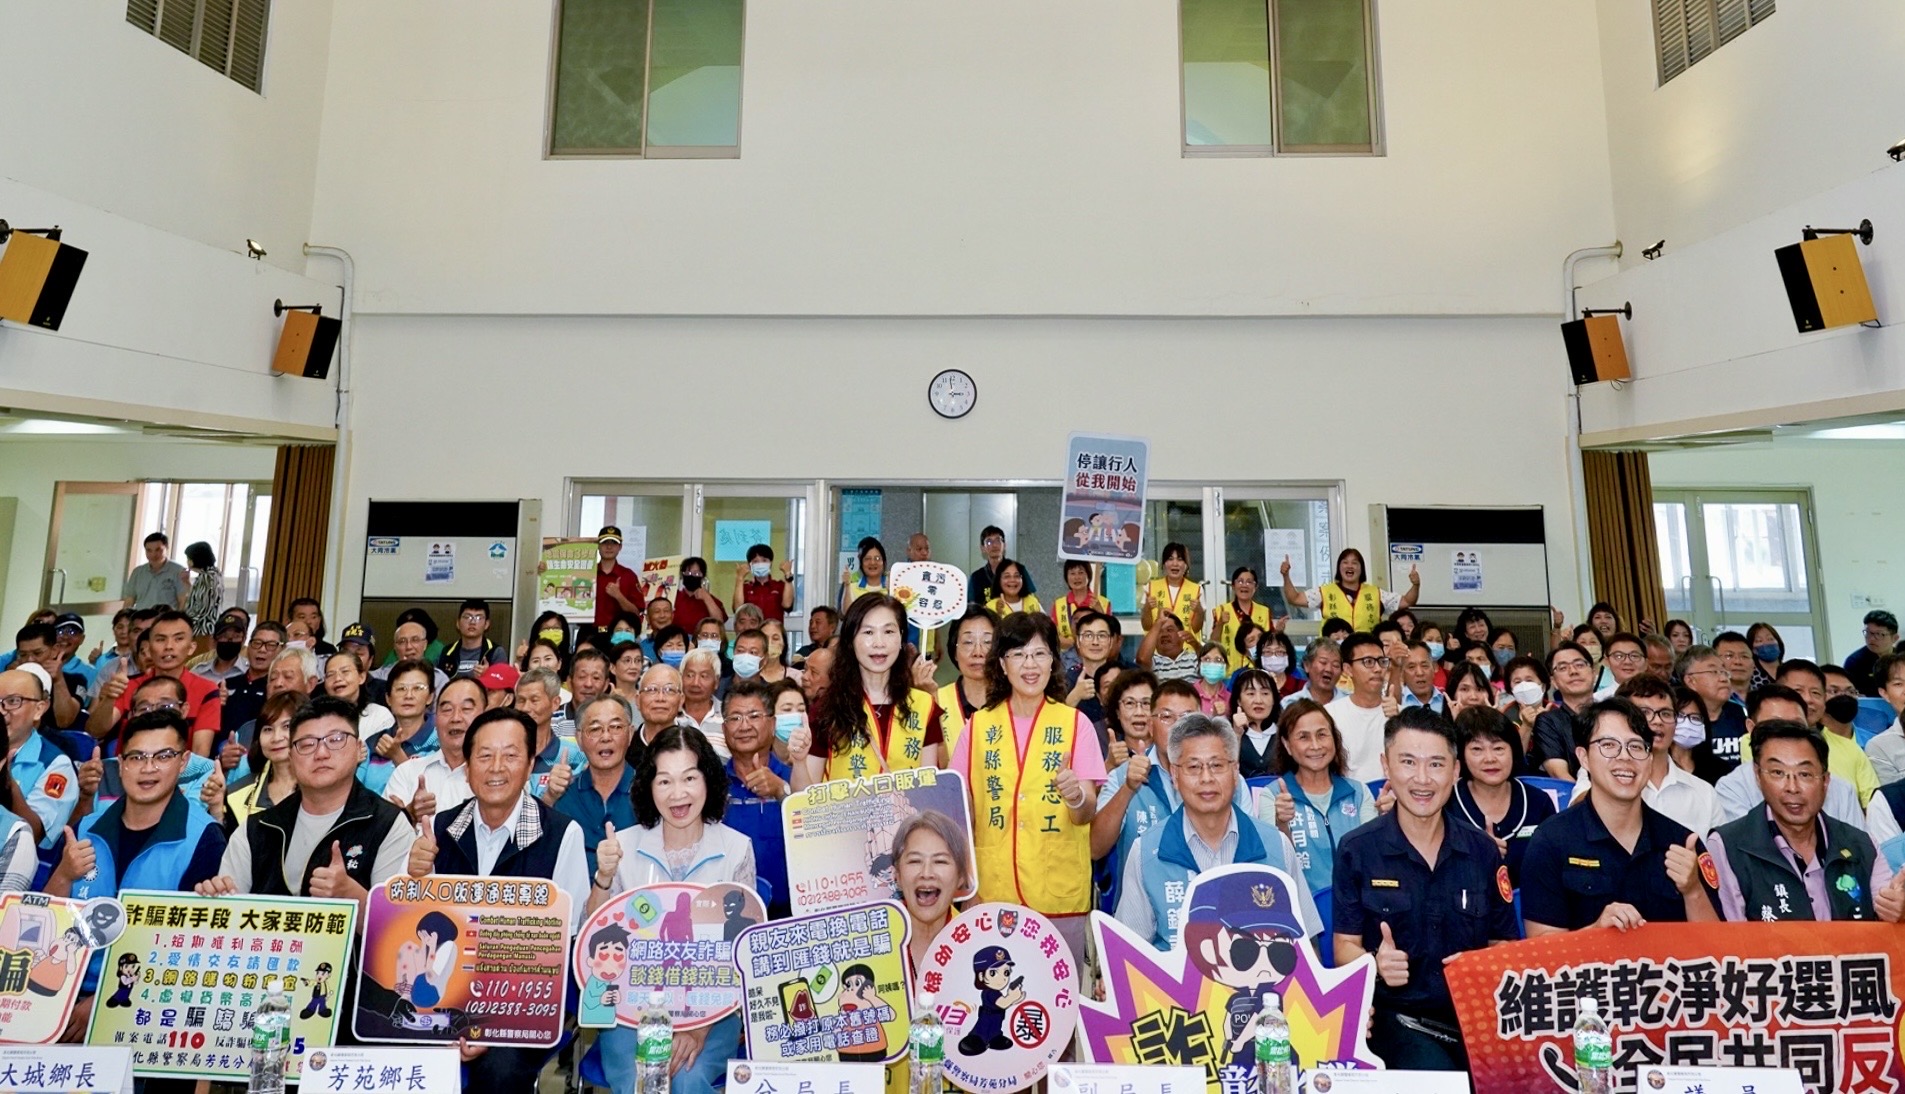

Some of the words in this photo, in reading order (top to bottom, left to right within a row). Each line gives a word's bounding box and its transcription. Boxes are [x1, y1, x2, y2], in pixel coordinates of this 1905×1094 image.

[1077, 453, 1137, 473] 停讓行人
[1075, 472, 1136, 492] 從我開始
[919, 597, 943, 610] 容忍
[927, 585, 938, 596] 零
[807, 769, 938, 805] 打擊人口販運
[984, 723, 1005, 831] 彰縣警局
[1040, 725, 1064, 834] 服務志工
[23, 894, 49, 907] ATM
[390, 880, 549, 905] 防制人口販運通報專線
[1774, 884, 1792, 914] 鎮長
[126, 904, 231, 930] 詐騙新手段
[240, 908, 347, 934] 大家要防範
[749, 907, 889, 954] 親友來電換電話
[629, 938, 732, 962] 網路交友詐騙
[751, 932, 893, 978] 講到匯錢就是騙
[465, 1001, 558, 1017] (02)2388-3095
[749, 996, 779, 1011] 好久不見
[1499, 957, 1897, 1036] 維護乾淨好選風
[764, 1005, 891, 1043] 務必撥打原本舊號碼
[1015, 1008, 1044, 1042] 暴
[1234, 1013, 1252, 1025] PO
[168, 1031, 206, 1049] 110
[484, 1028, 552, 1039] 彰化縣警察局關心您
[781, 1027, 880, 1057] 或家用電話查證
[1131, 1006, 1218, 1082] 詐
[0, 1061, 96, 1090] 大城鄉長
[328, 1064, 426, 1091] 芳苑鄉長
